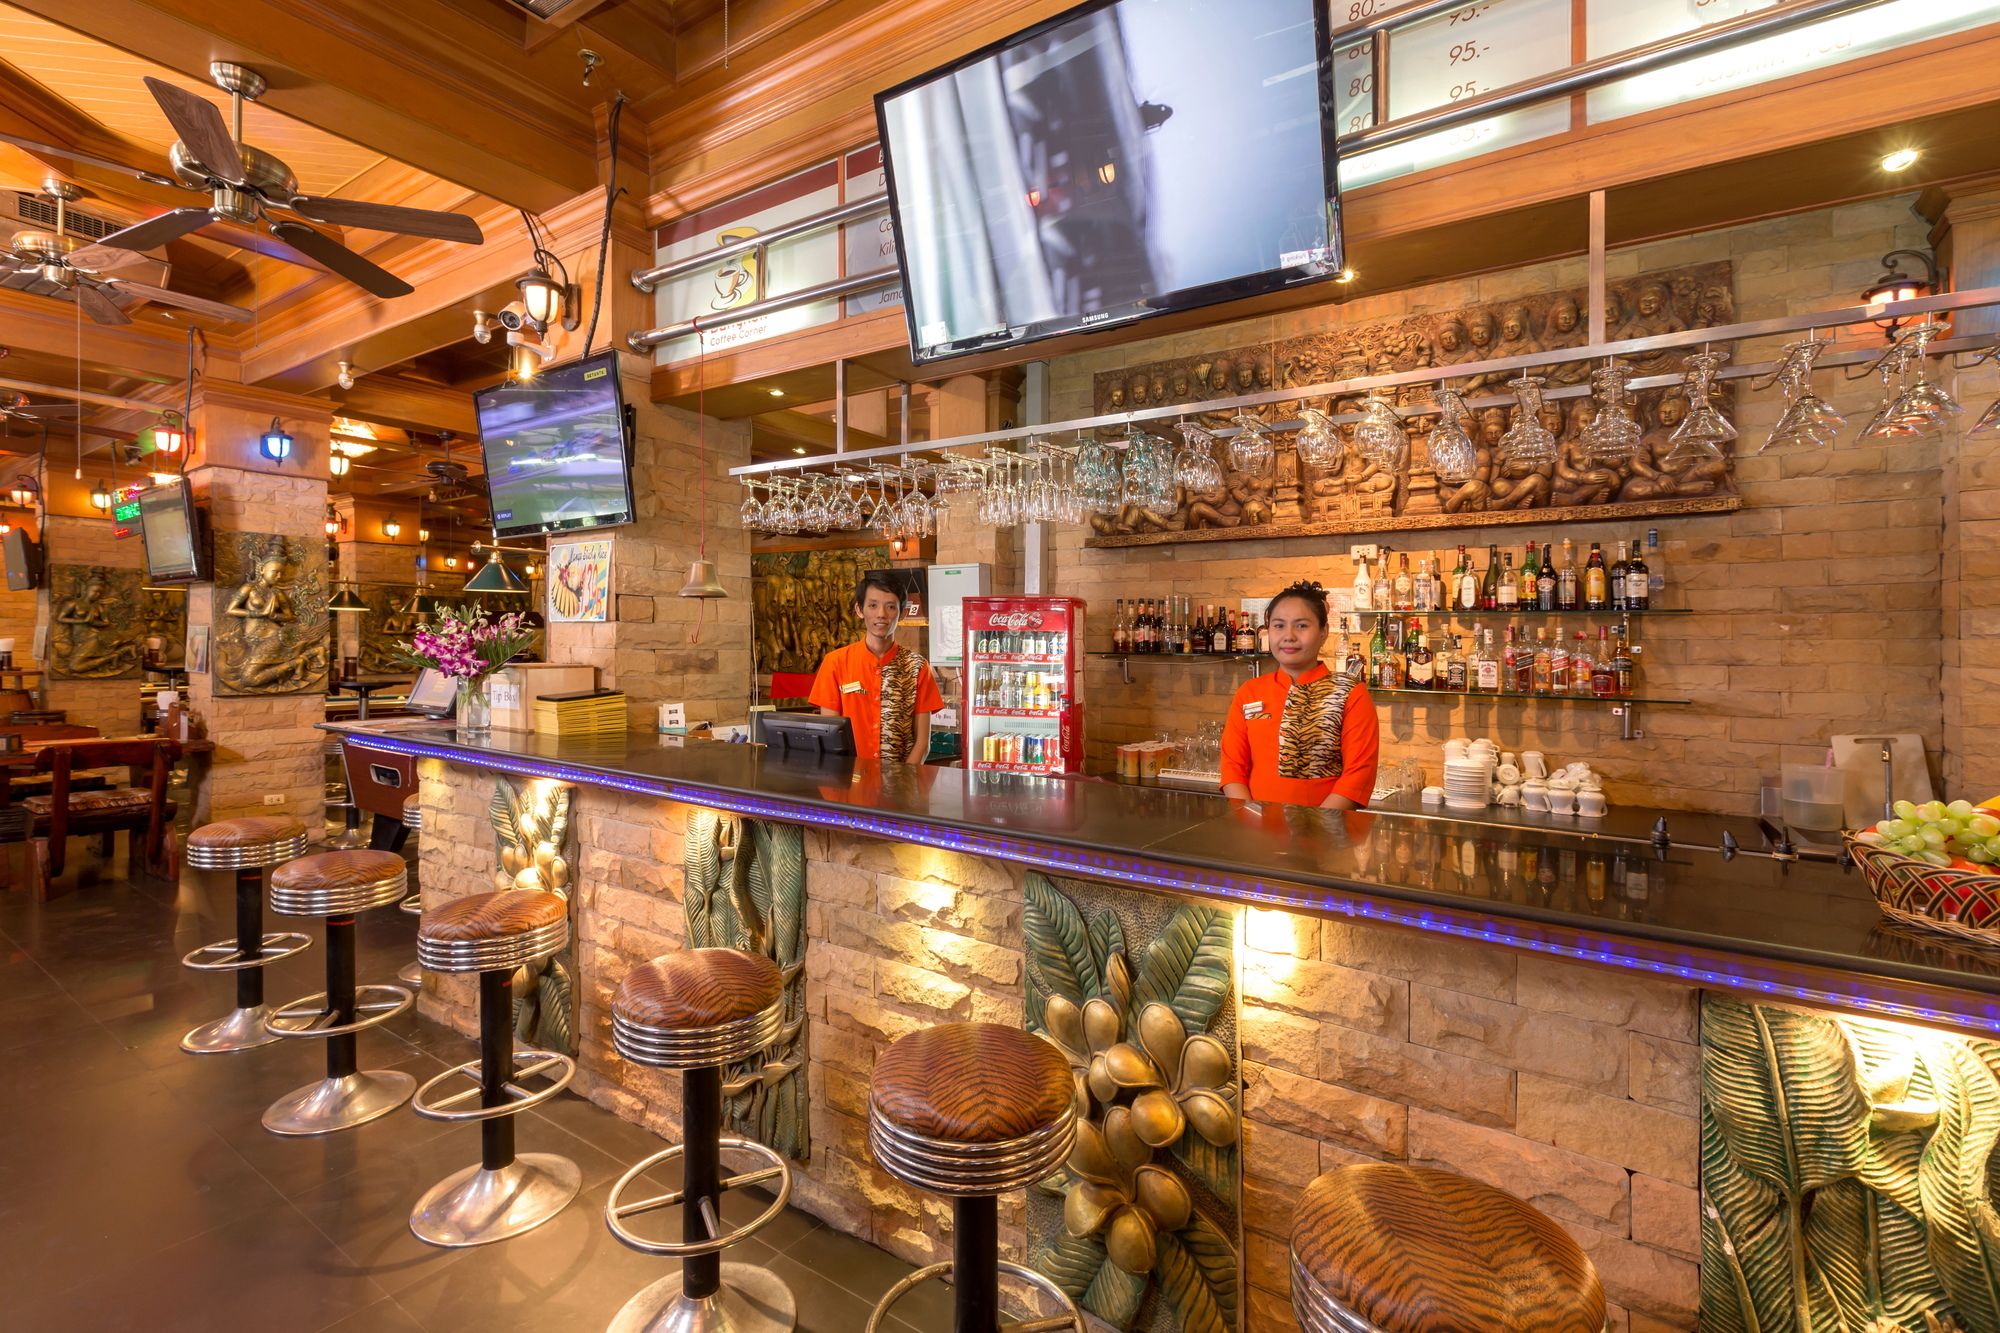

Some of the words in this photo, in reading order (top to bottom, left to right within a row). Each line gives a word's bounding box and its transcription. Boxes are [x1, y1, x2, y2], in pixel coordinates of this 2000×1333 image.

[1349, 0, 1386, 22] 80.-
[1449, 40, 1490, 66] 95.-
[1449, 81, 1490, 102] 95-
[1082, 312, 1109, 324] SAMSUNG
[710, 333, 737, 346] Coffee
[738, 325, 767, 339] Corner
[910, 606, 918, 615] 2
[989, 612, 1030, 628] Coca-Cola
[1061, 724, 1071, 753] Coca-Cola
